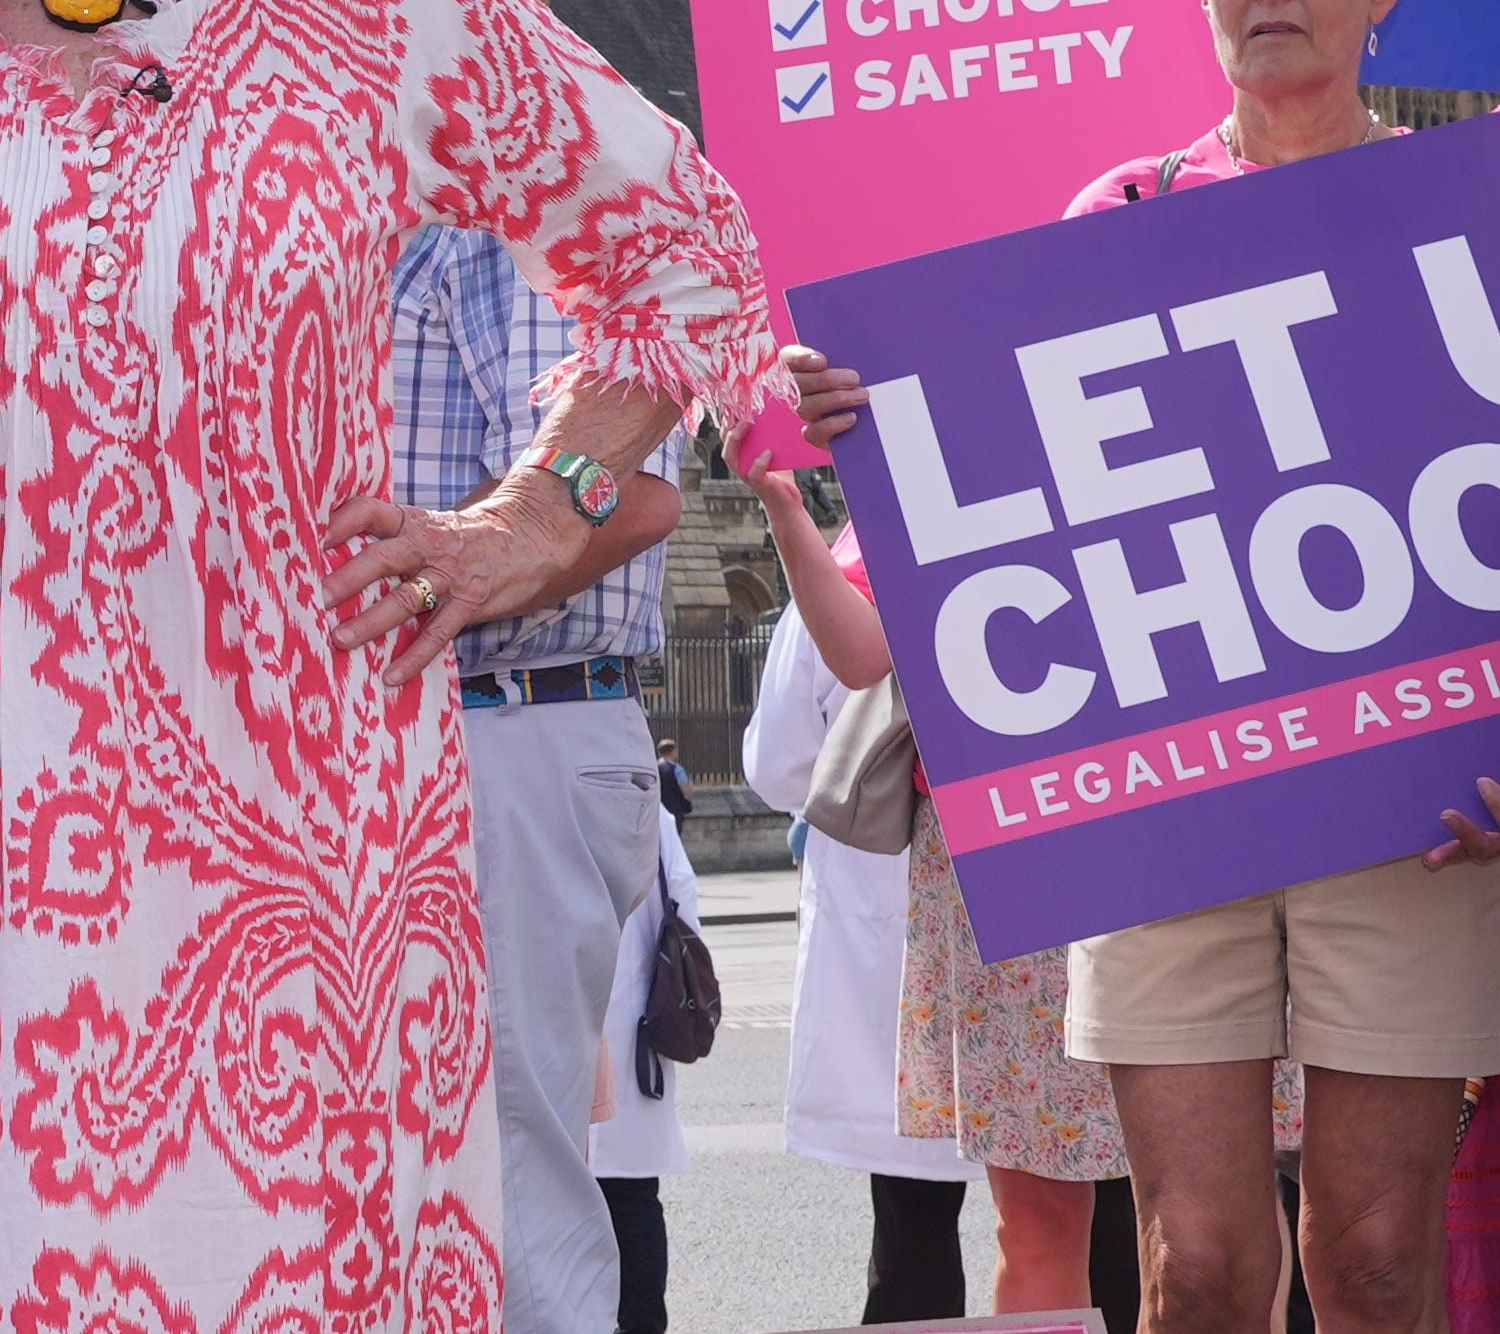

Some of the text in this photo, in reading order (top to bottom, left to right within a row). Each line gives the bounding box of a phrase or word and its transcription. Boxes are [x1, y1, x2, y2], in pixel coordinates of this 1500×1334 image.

[853, 25, 1135, 112] SAFETY
[867, 270, 1339, 566] LET
[987, 707, 1319, 828] LEGALISE
